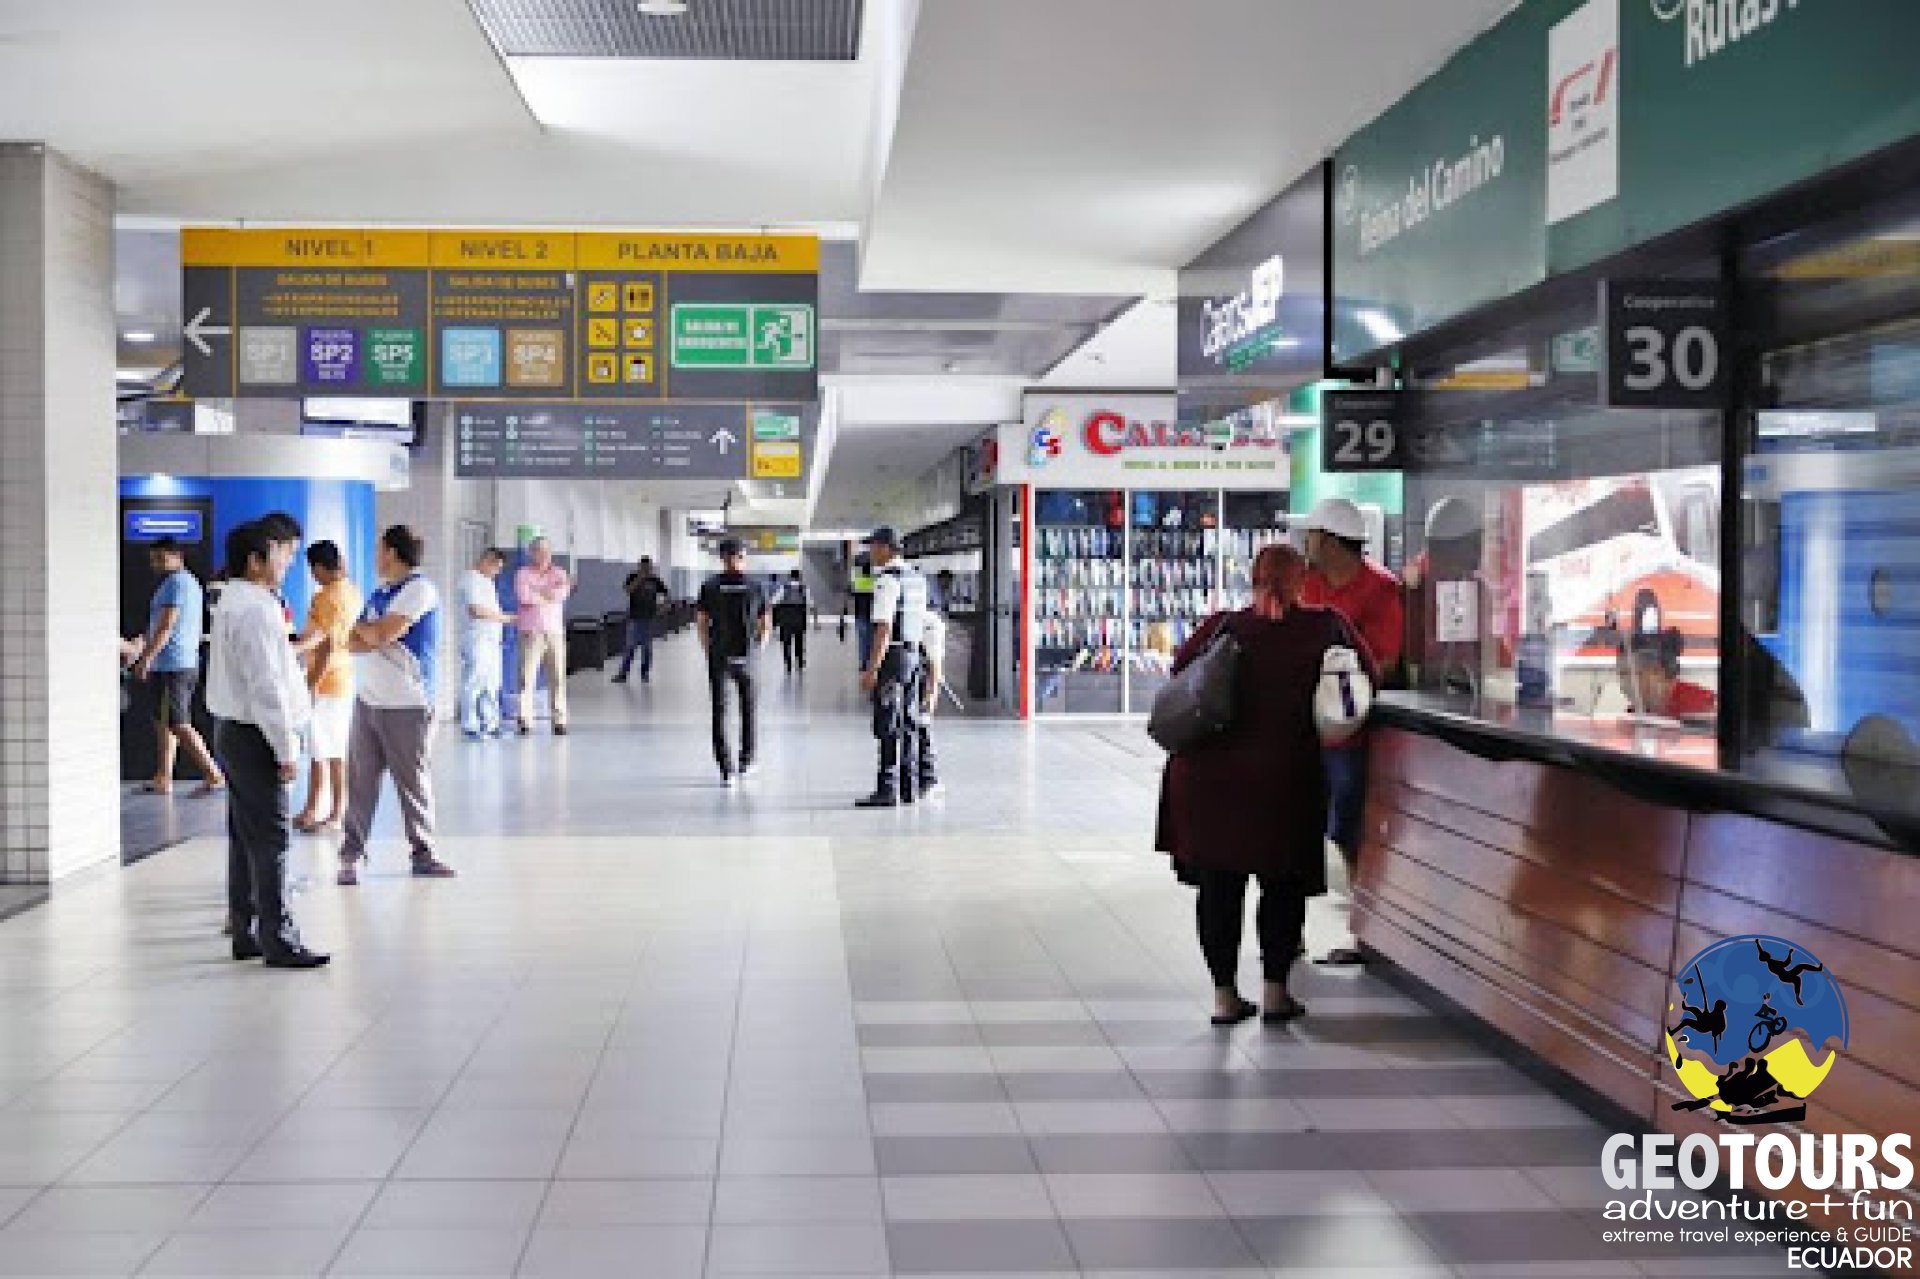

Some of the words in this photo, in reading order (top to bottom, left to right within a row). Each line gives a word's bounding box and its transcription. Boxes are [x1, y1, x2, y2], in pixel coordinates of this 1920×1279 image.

[1402, 165, 1429, 229] del
[1432, 134, 1505, 211] Camino
[285, 239, 355, 257] NIVEL
[460, 240, 528, 258] NIVEL
[536, 240, 549, 258] 2
[618, 243, 709, 261] PLANTA
[716, 244, 780, 262] BAJA
[310, 344, 354, 362] SP2
[371, 344, 415, 362] SP5
[1623, 326, 1719, 391] 30
[1334, 420, 1397, 462] 29
